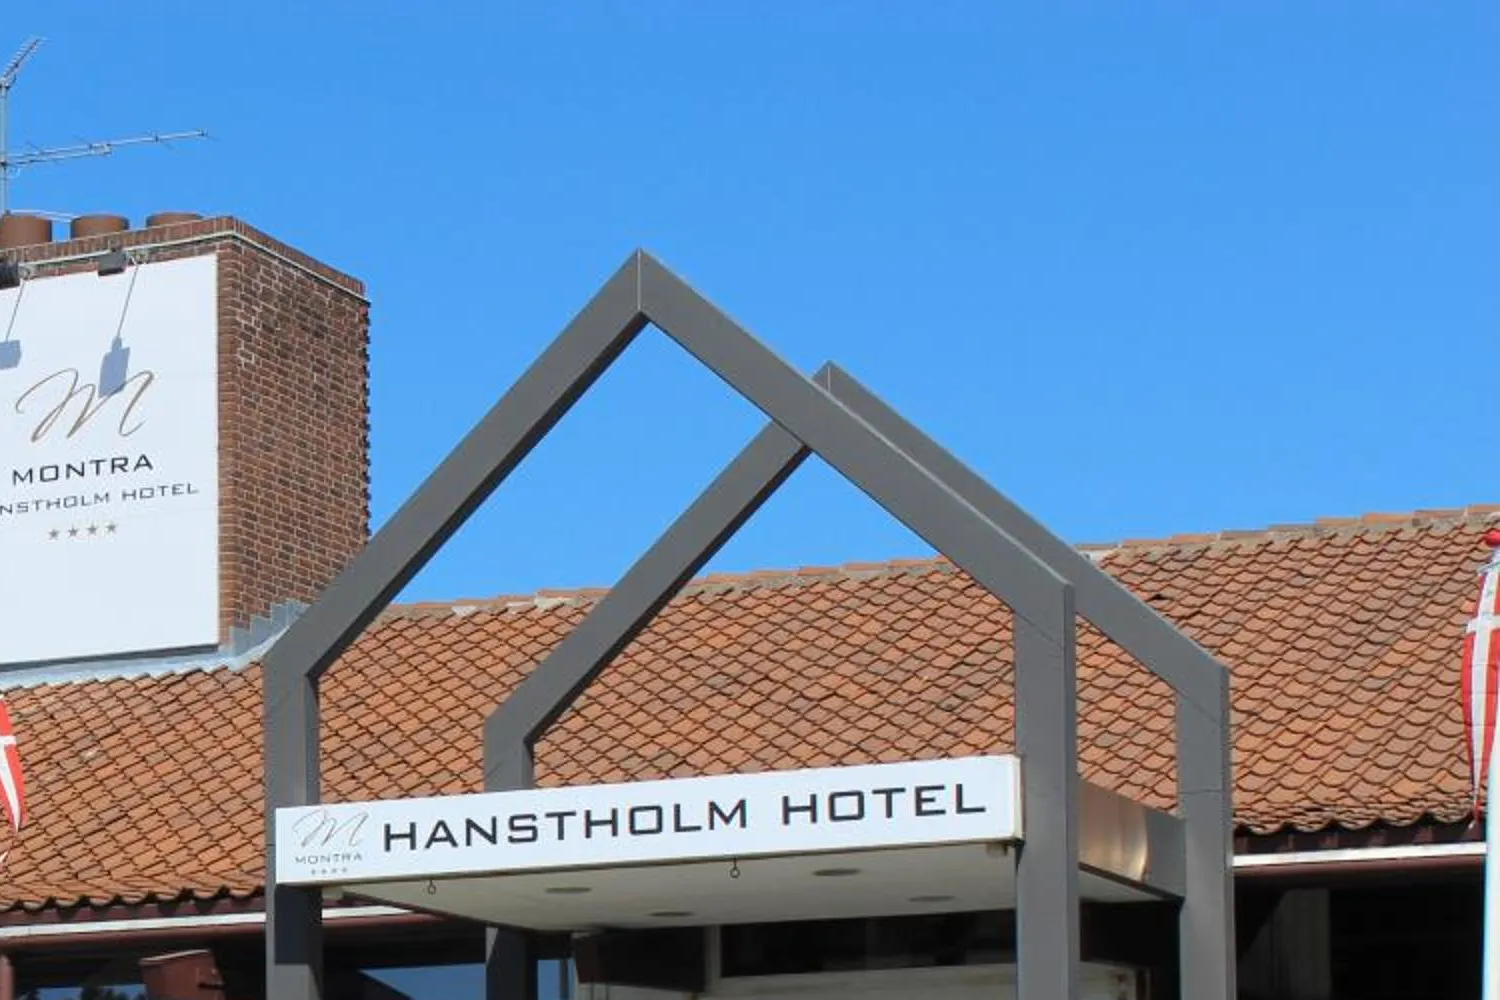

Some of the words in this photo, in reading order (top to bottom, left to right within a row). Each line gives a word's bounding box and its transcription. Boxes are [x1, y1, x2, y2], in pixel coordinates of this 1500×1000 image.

[12, 452, 154, 487] MONTRA
[121, 482, 200, 501] HOTEL
[383, 797, 749, 853] HANSTHOLM
[780, 782, 987, 827] HOTEL
[295, 852, 362, 865] MONTRA
